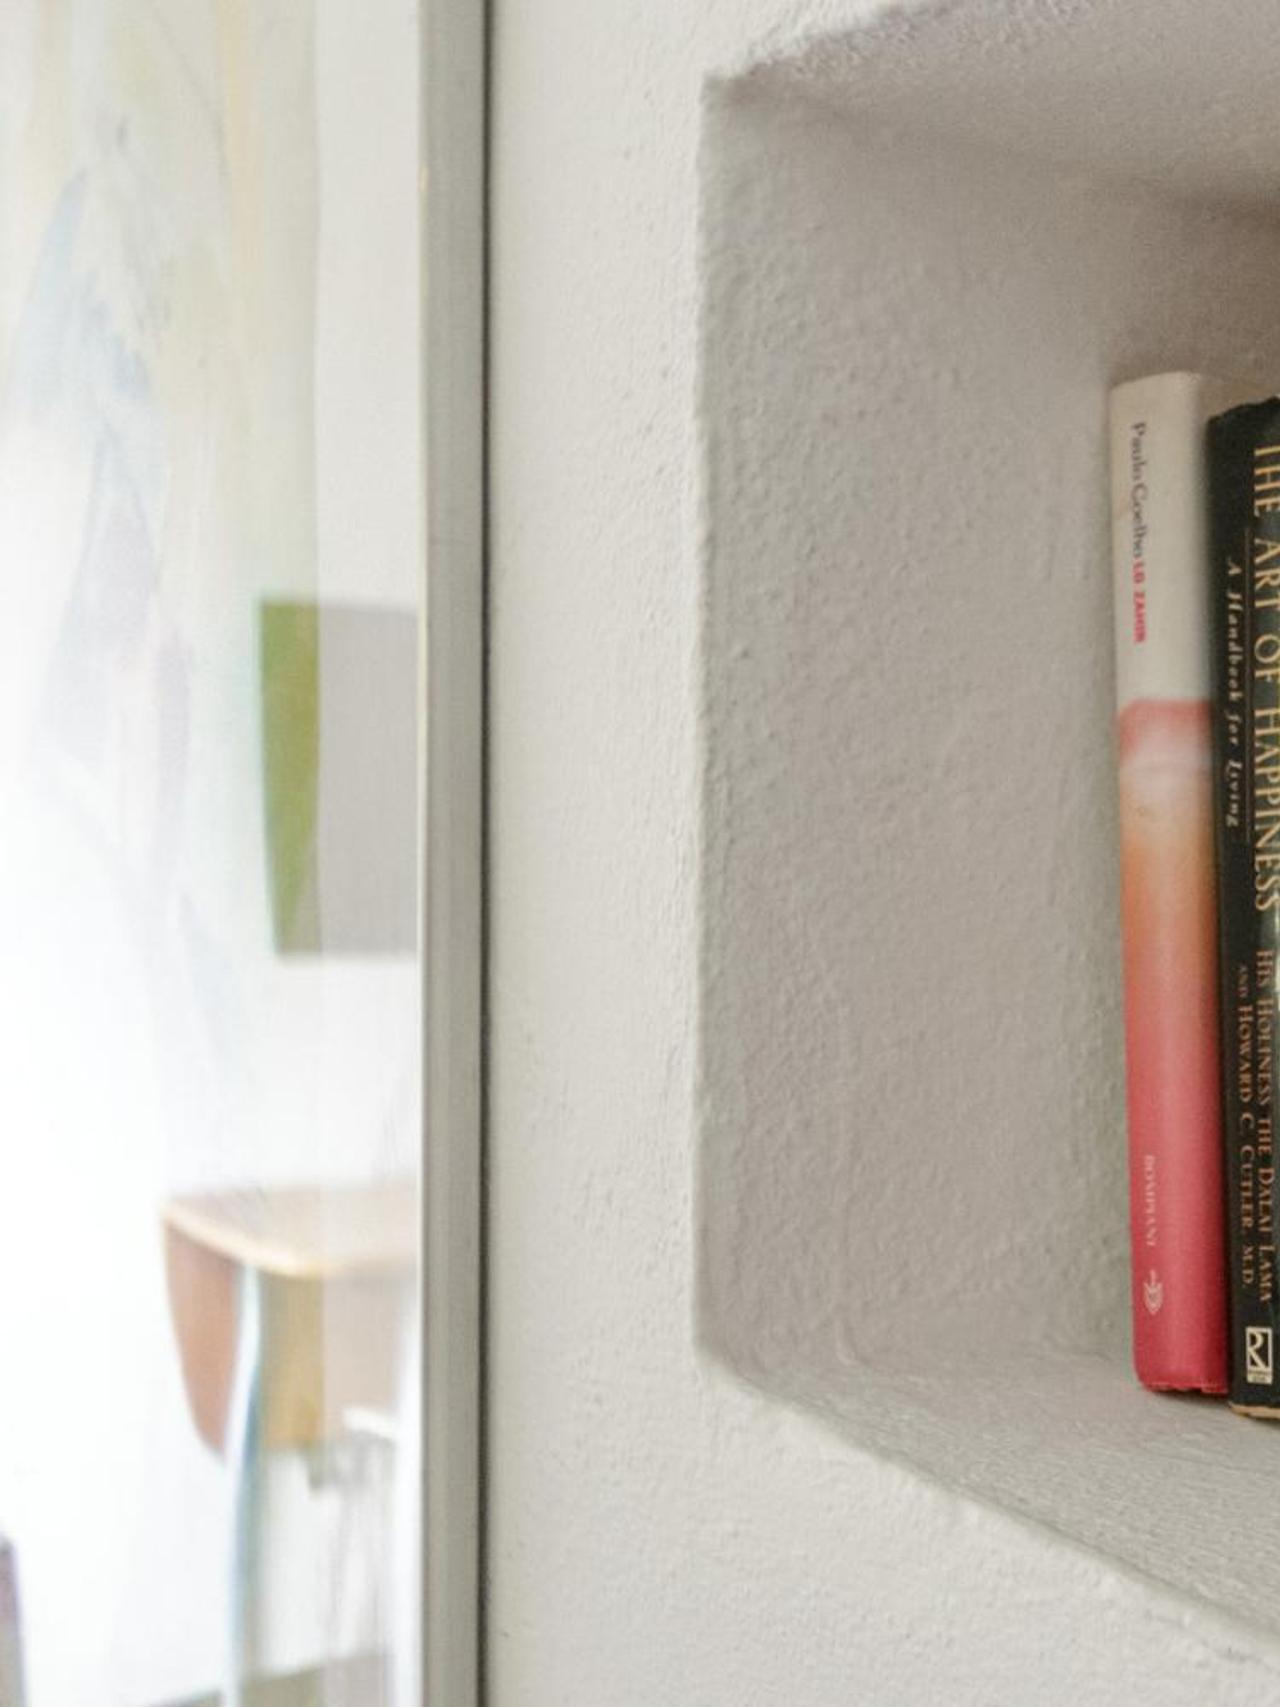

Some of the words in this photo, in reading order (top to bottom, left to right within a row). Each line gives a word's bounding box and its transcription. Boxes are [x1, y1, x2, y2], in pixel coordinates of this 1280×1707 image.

[1131, 423, 1147, 480] Paulo
[1132, 483, 1147, 558] Coelho
[1228, 560, 1241, 575] A
[1228, 592, 1242, 701] Handbook
[1225, 712, 1242, 746] for
[1226, 760, 1242, 827] Living
[1256, 951, 1274, 987] HIS
[1238, 1005, 1253, 1103] HOWARD
[1257, 999, 1274, 1105] HOLINESS
[1258, 1119, 1272, 1157] THE
[1258, 1168, 1275, 1232] DALAI
[1259, 1245, 1275, 1301] LAMA
